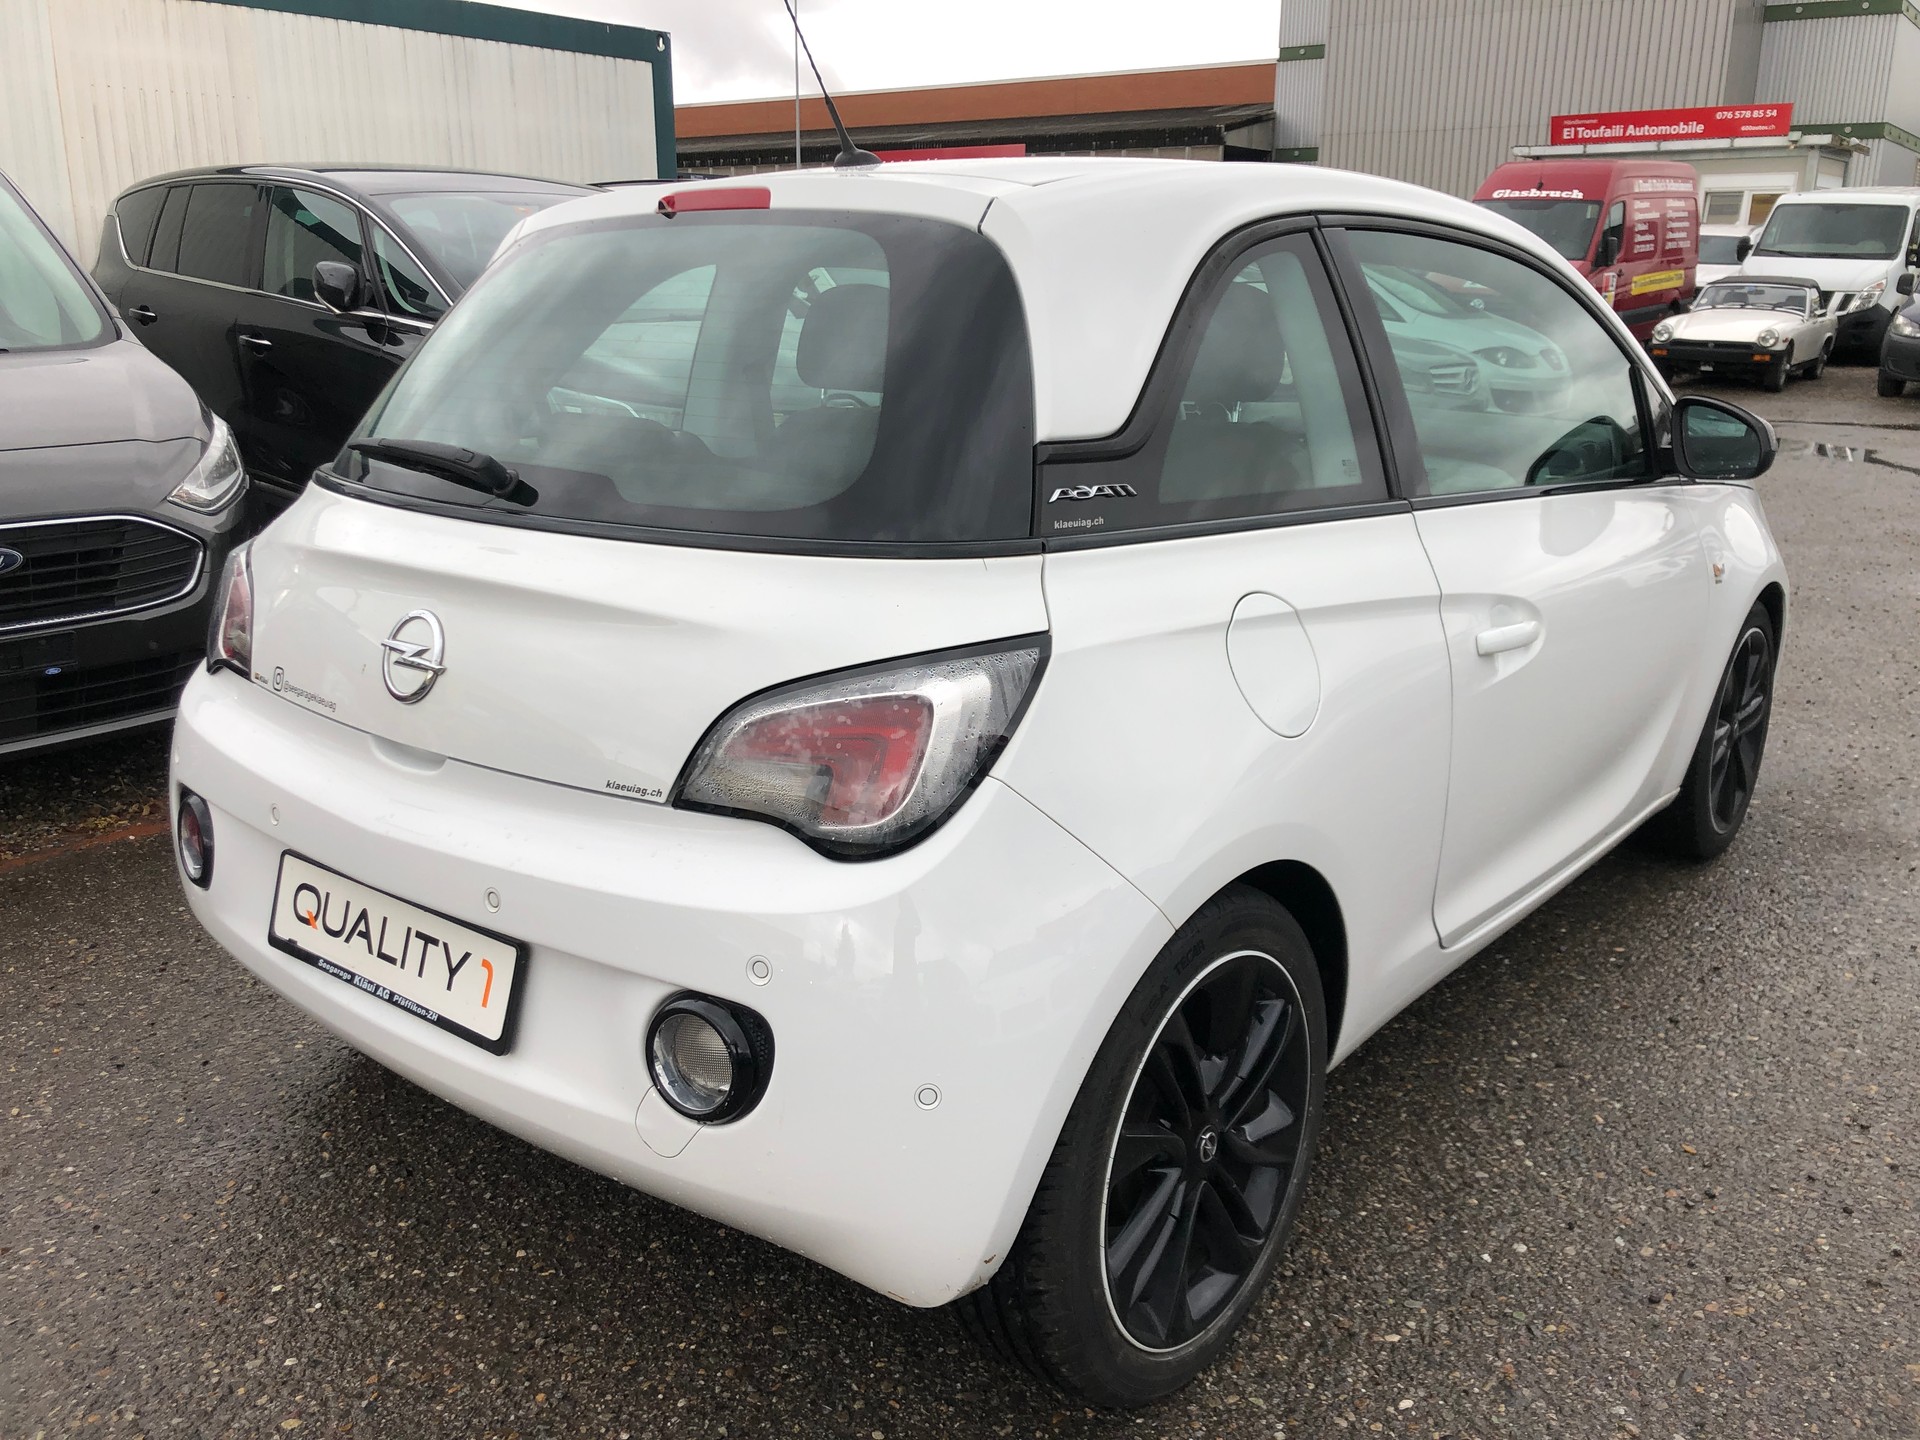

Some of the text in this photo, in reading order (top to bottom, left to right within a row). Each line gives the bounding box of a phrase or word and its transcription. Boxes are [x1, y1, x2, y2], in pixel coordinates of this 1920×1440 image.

[1716, 108, 1778, 120] 076 578 85 54
[1563, 121, 1705, 140] El Toufaili Automobile
[1492, 188, 1584, 199] Glasbruch
[1054, 516, 1104, 530] klaeuiag.ch
[605, 780, 663, 797] klaeuiag.ch
[293, 882, 472, 992] QUALITY
[317, 958, 439, 1022] Seegarage Kläui AG Pfäffikon-ZH
